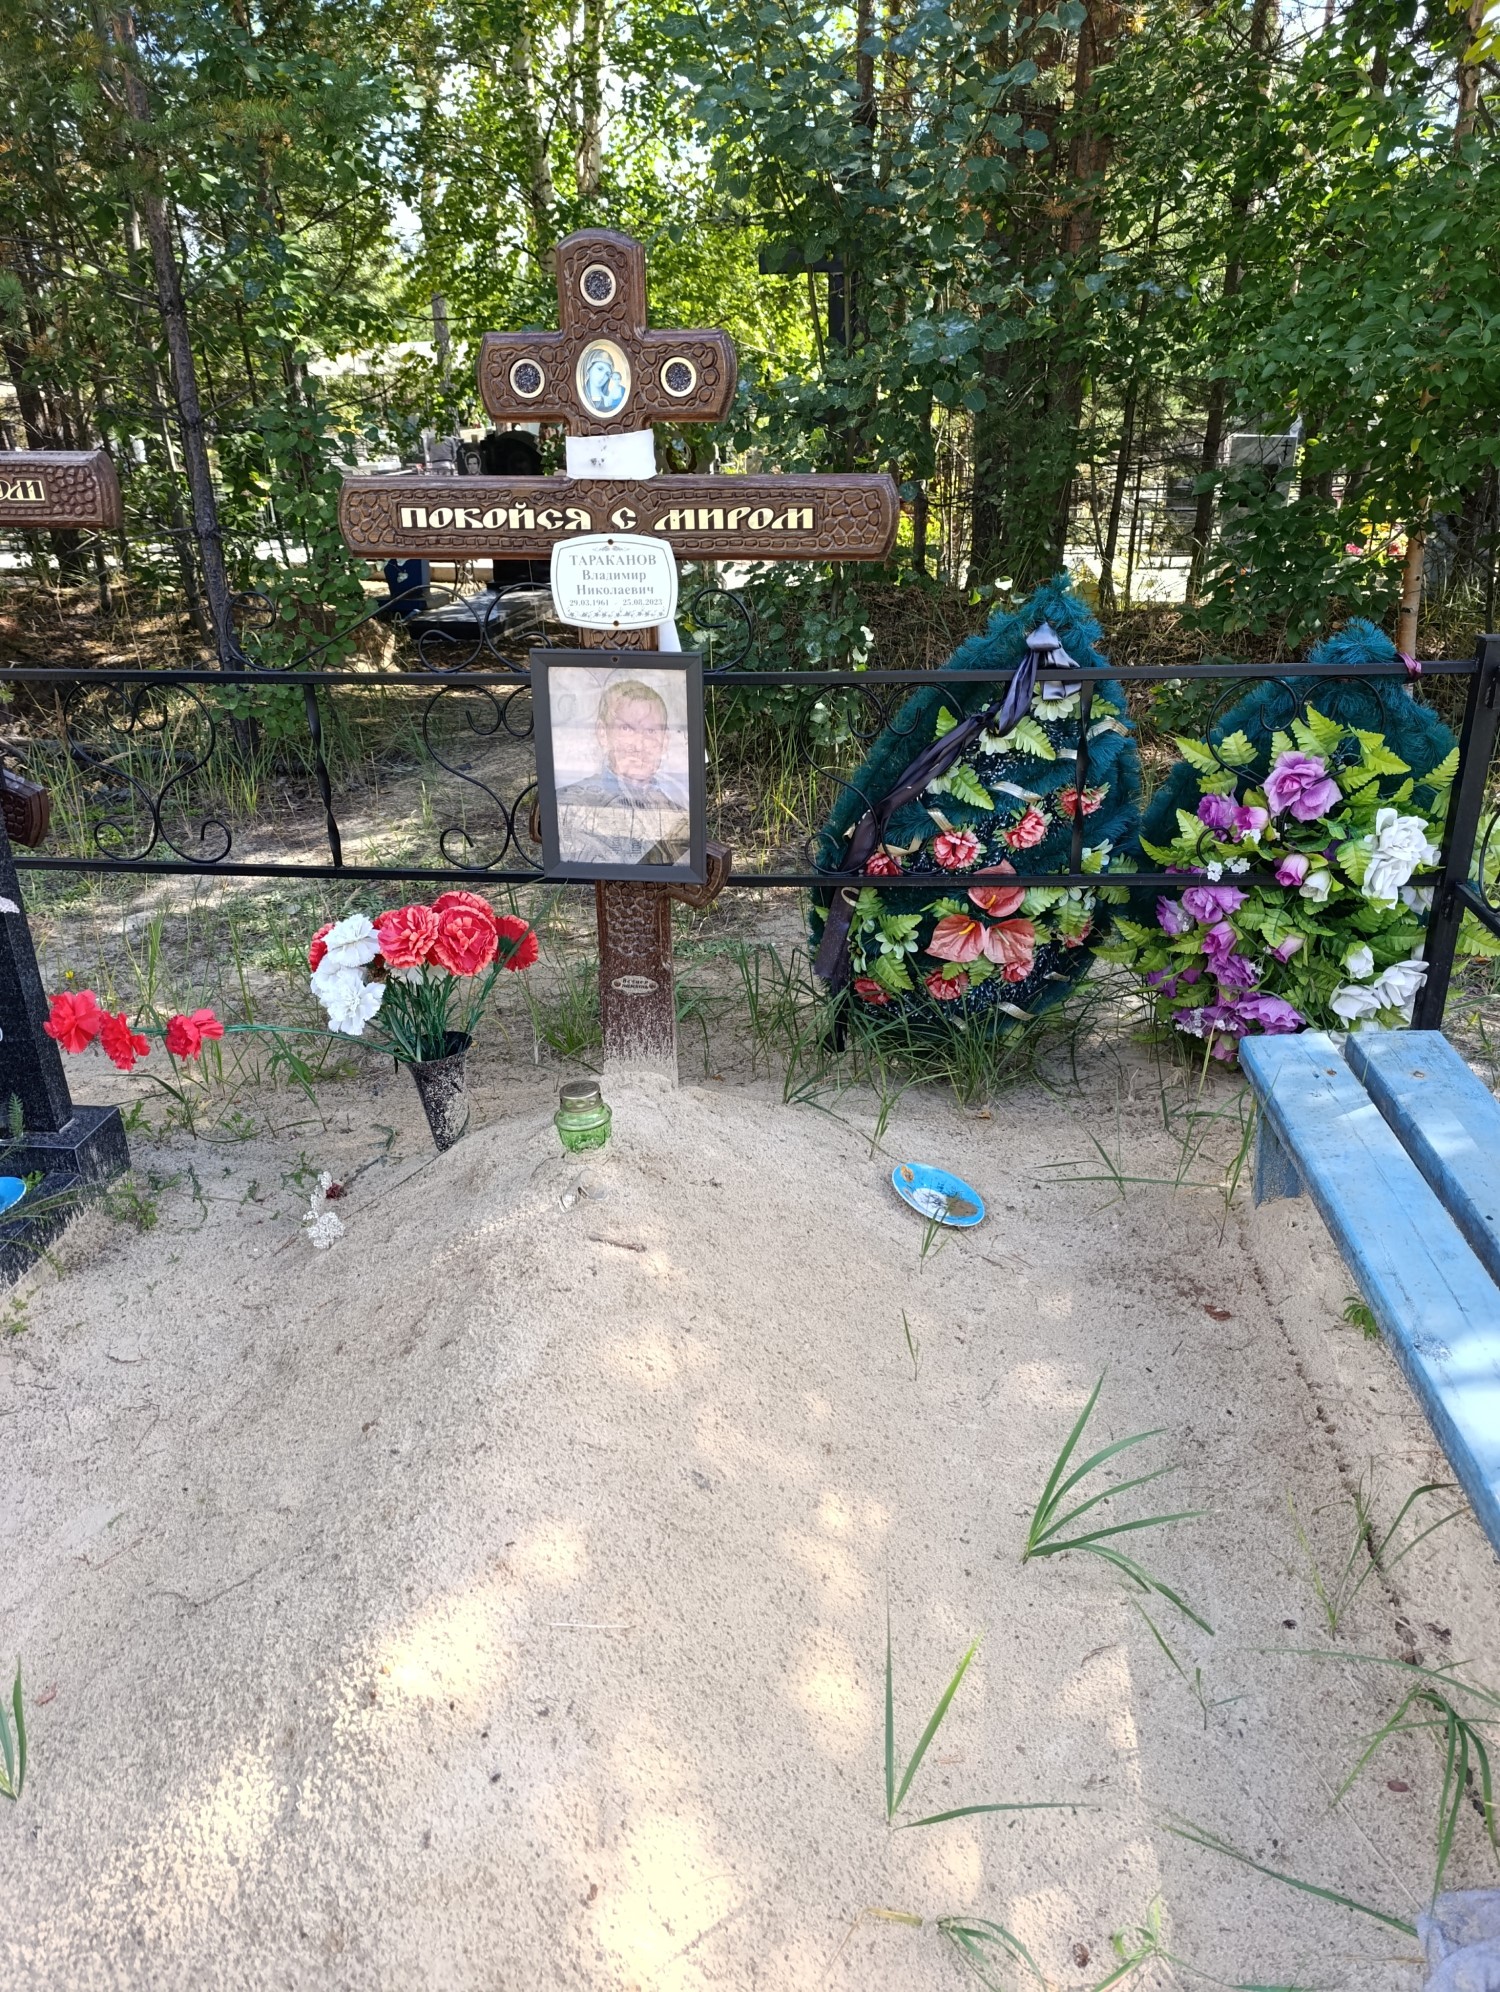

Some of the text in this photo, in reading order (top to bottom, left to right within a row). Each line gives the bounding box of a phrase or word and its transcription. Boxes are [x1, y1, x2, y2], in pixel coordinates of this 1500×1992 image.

[569, 554, 657, 566] ТАРАКАНОВ
[582, 569, 647, 583] Владимир
[576, 584, 654, 595] Николаевич
[569, 599, 609, 607] 29.03.1961
[622, 598, 663, 606] 25.08.2023
